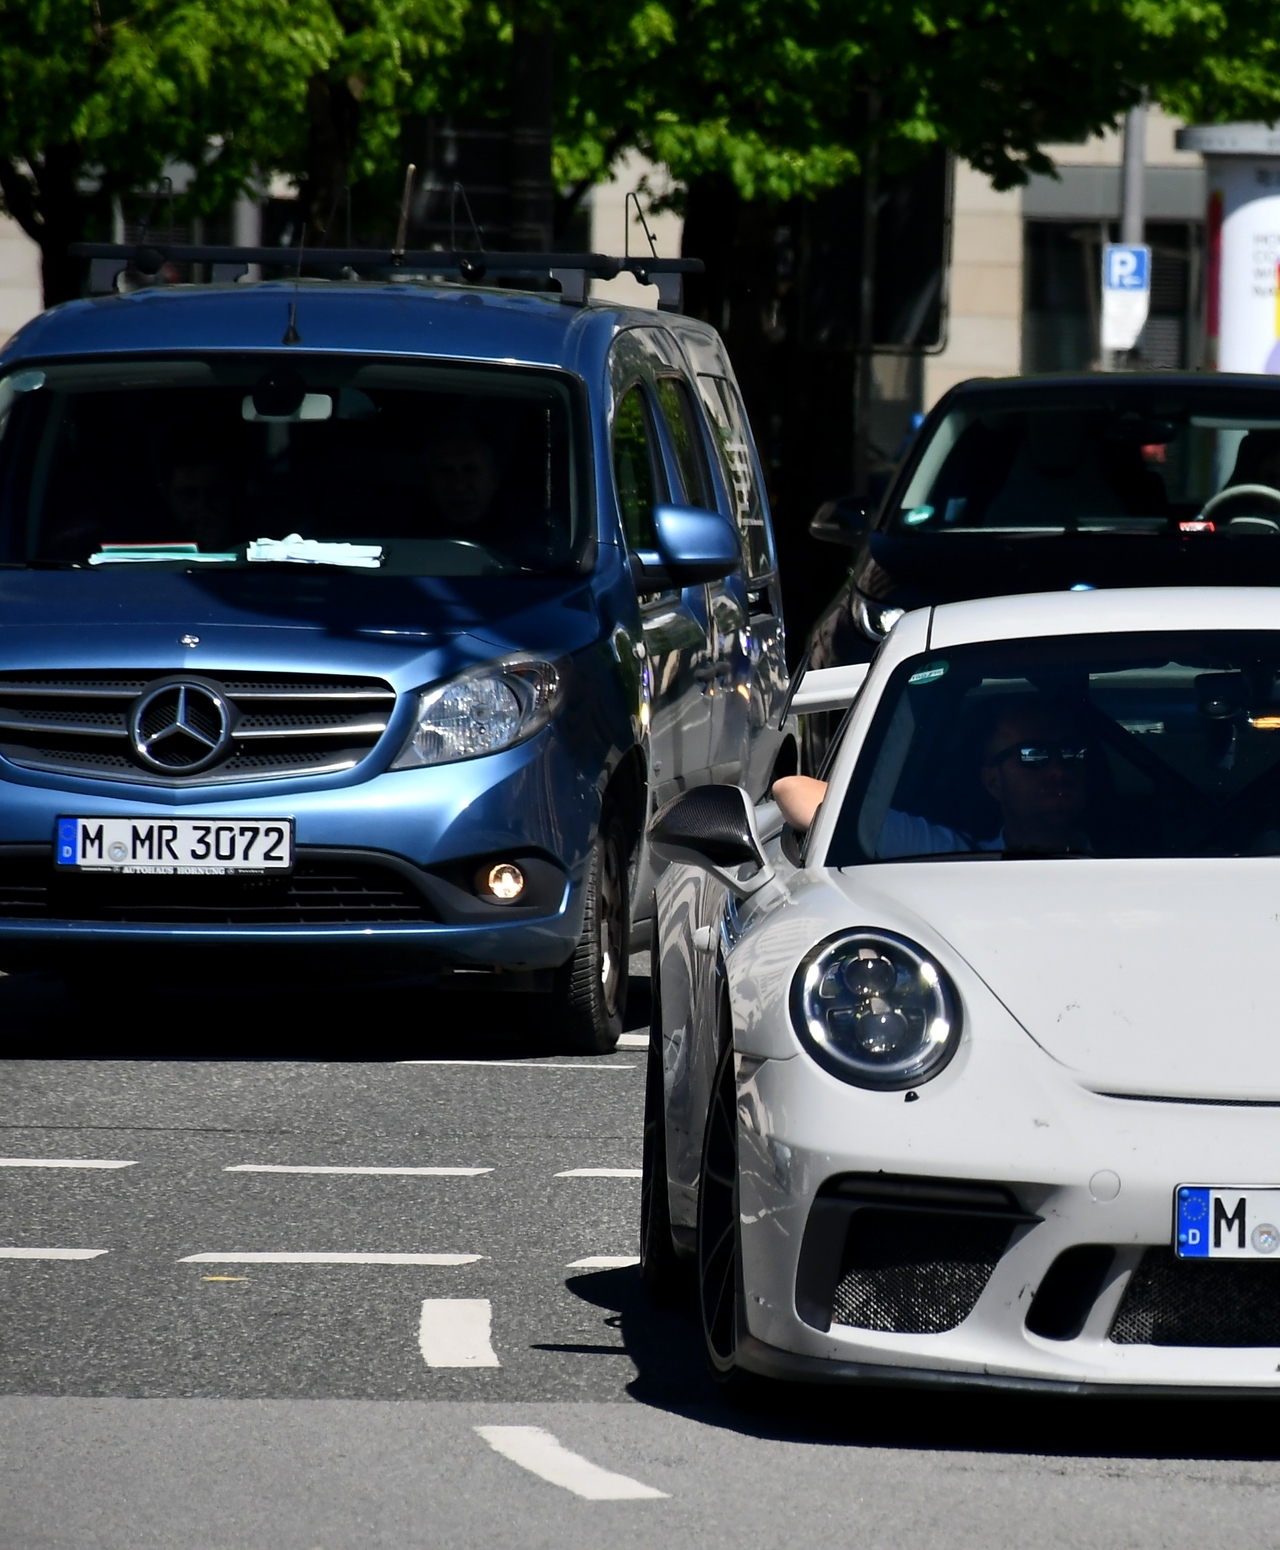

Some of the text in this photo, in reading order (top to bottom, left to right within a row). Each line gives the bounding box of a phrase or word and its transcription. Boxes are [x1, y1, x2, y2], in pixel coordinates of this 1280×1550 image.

[1110, 250, 1137, 286] P
[62, 825, 285, 862] D M MR 3072
[122, 867, 225, 876] AUTOHAUS HORNUNG
[1188, 1229, 1200, 1245] D
[1214, 1197, 1247, 1249] M
